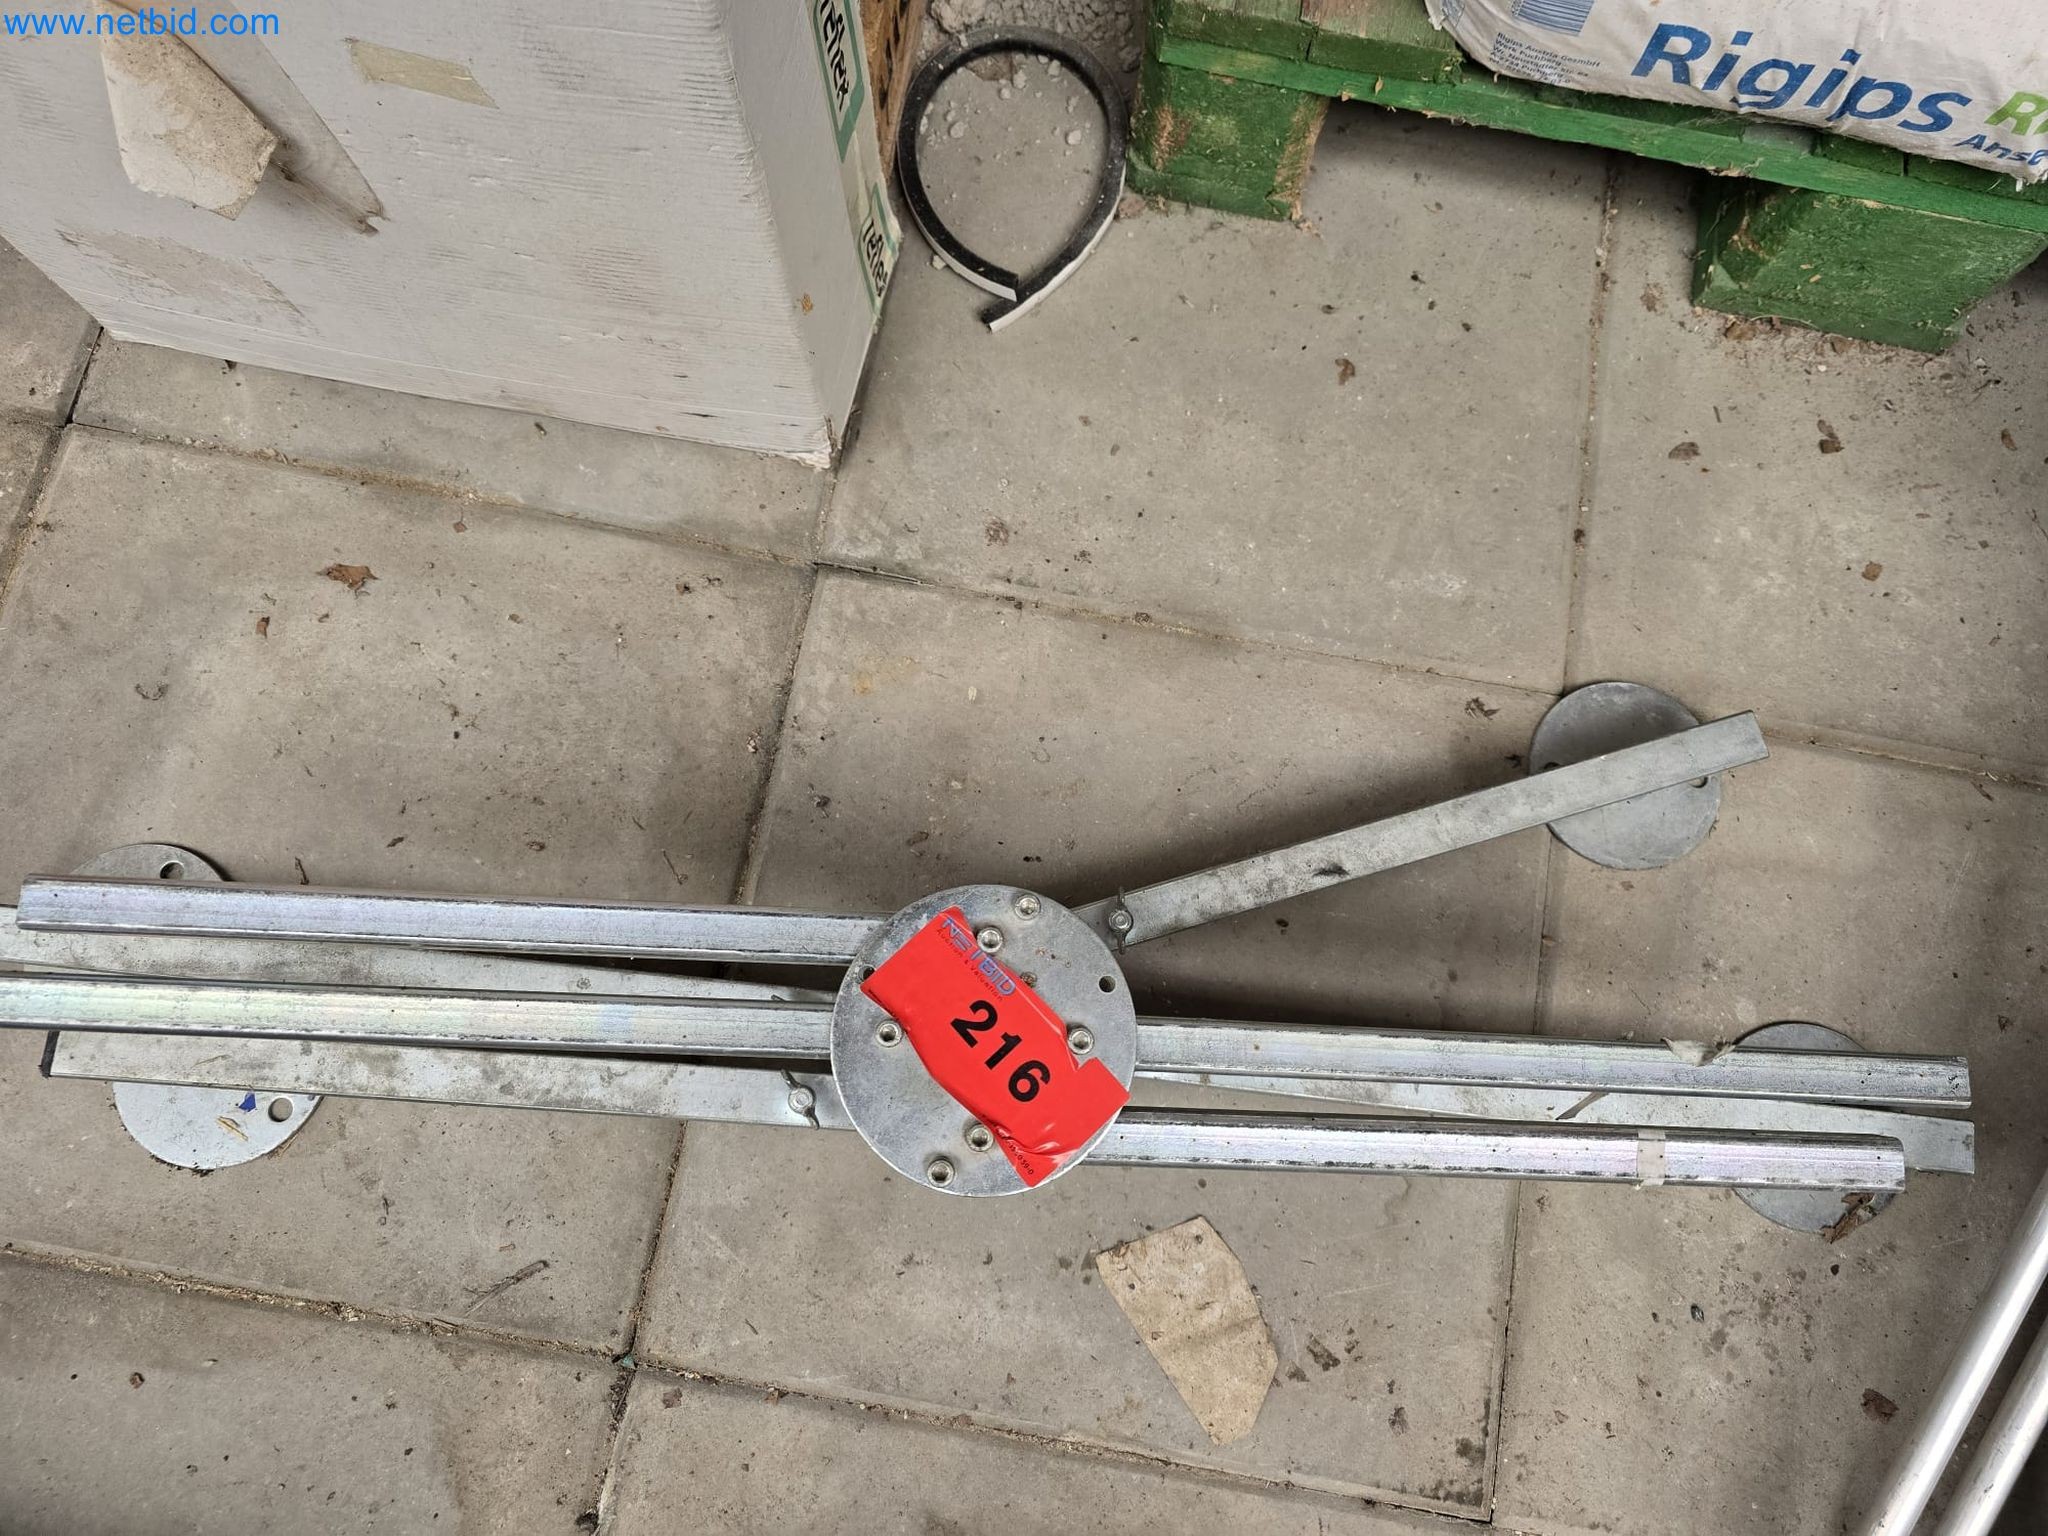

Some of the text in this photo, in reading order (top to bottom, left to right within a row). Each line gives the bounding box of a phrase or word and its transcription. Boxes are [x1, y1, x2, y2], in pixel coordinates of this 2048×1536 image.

[1631, 23, 2048, 136] Rigips R
[950, 1000, 1051, 1102] 216
